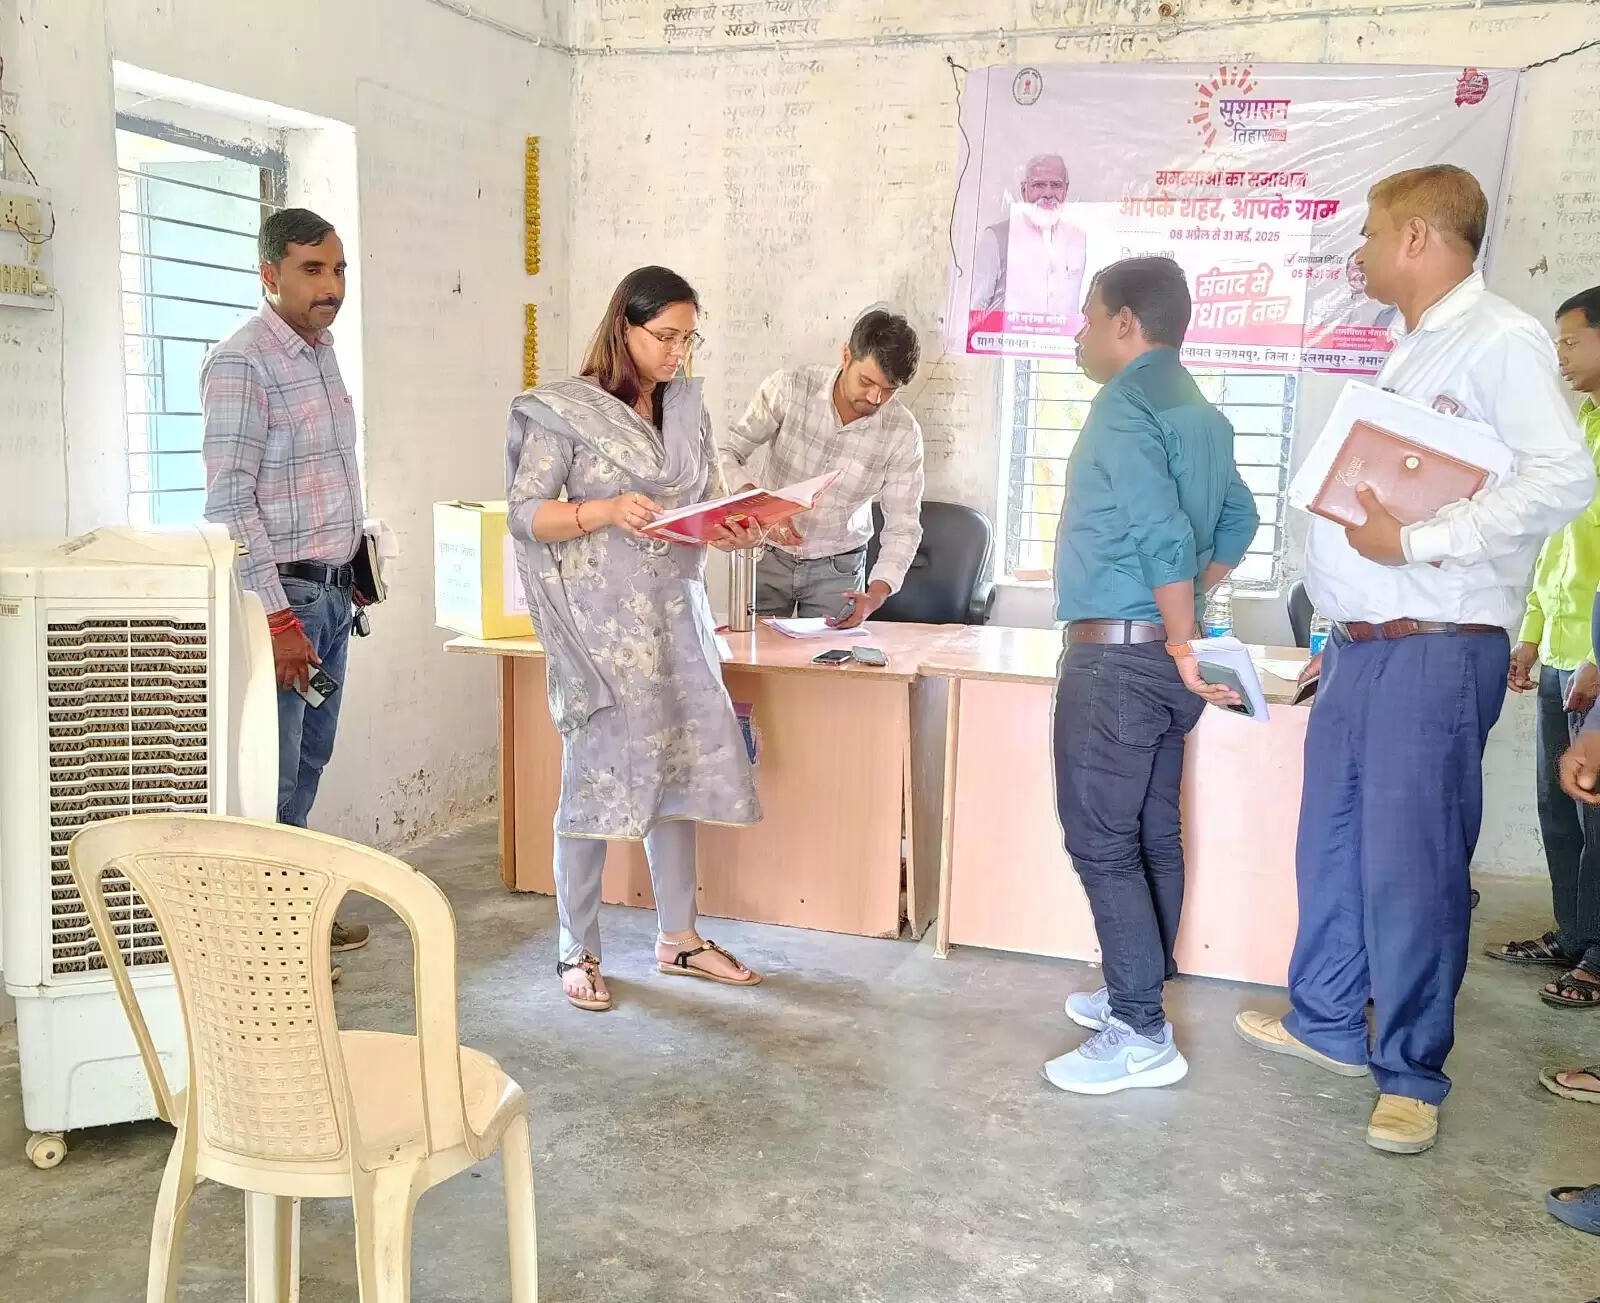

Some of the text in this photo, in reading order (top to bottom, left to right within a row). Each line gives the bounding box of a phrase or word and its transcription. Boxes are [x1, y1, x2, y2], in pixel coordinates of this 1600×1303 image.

[1219, 99, 1291, 127] सुशासन
[1233, 121, 1269, 144] तिहार
[1225, 171, 1245, 188] का
[1247, 171, 1308, 188] समाधान
[1119, 191, 1340, 222] आपके शहर, आपके ग्राम
[1169, 230, 1183, 240] 08
[1185, 226, 1210, 241] अप्रैल
[1211, 228, 1221, 241] से
[1223, 230, 1233, 241] 31
[1255, 231, 1280, 242] 2025
[1198, 265, 1271, 297] संवाद से
[1292, 269, 1303, 278] 05
